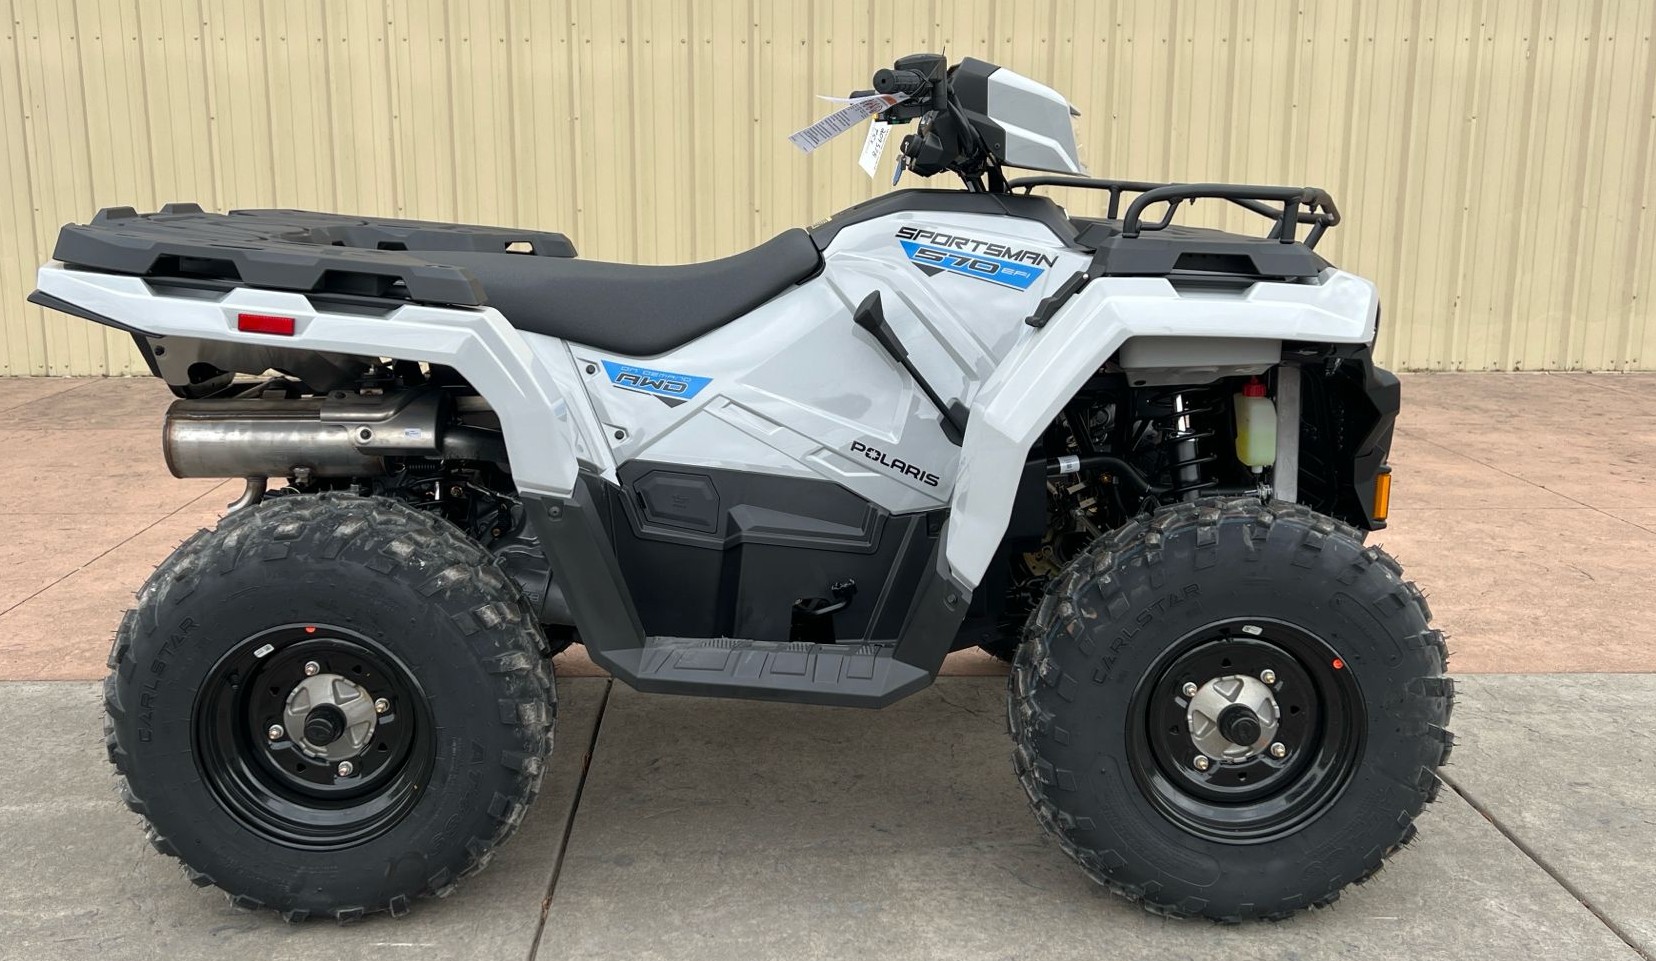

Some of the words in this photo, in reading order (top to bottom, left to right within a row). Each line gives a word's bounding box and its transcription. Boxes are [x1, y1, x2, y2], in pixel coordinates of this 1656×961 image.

[895, 226, 1059, 268] SPORTSMAN
[914, 246, 1000, 276] 570
[1001, 268, 1031, 279] EFI
[616, 372, 688, 393] AWD
[642, 370, 692, 382] DEMAND
[850, 440, 940, 487] POLARIS
[1092, 583, 1201, 685] CARLSTAR
[138, 617, 200, 743] CARLSTAR
